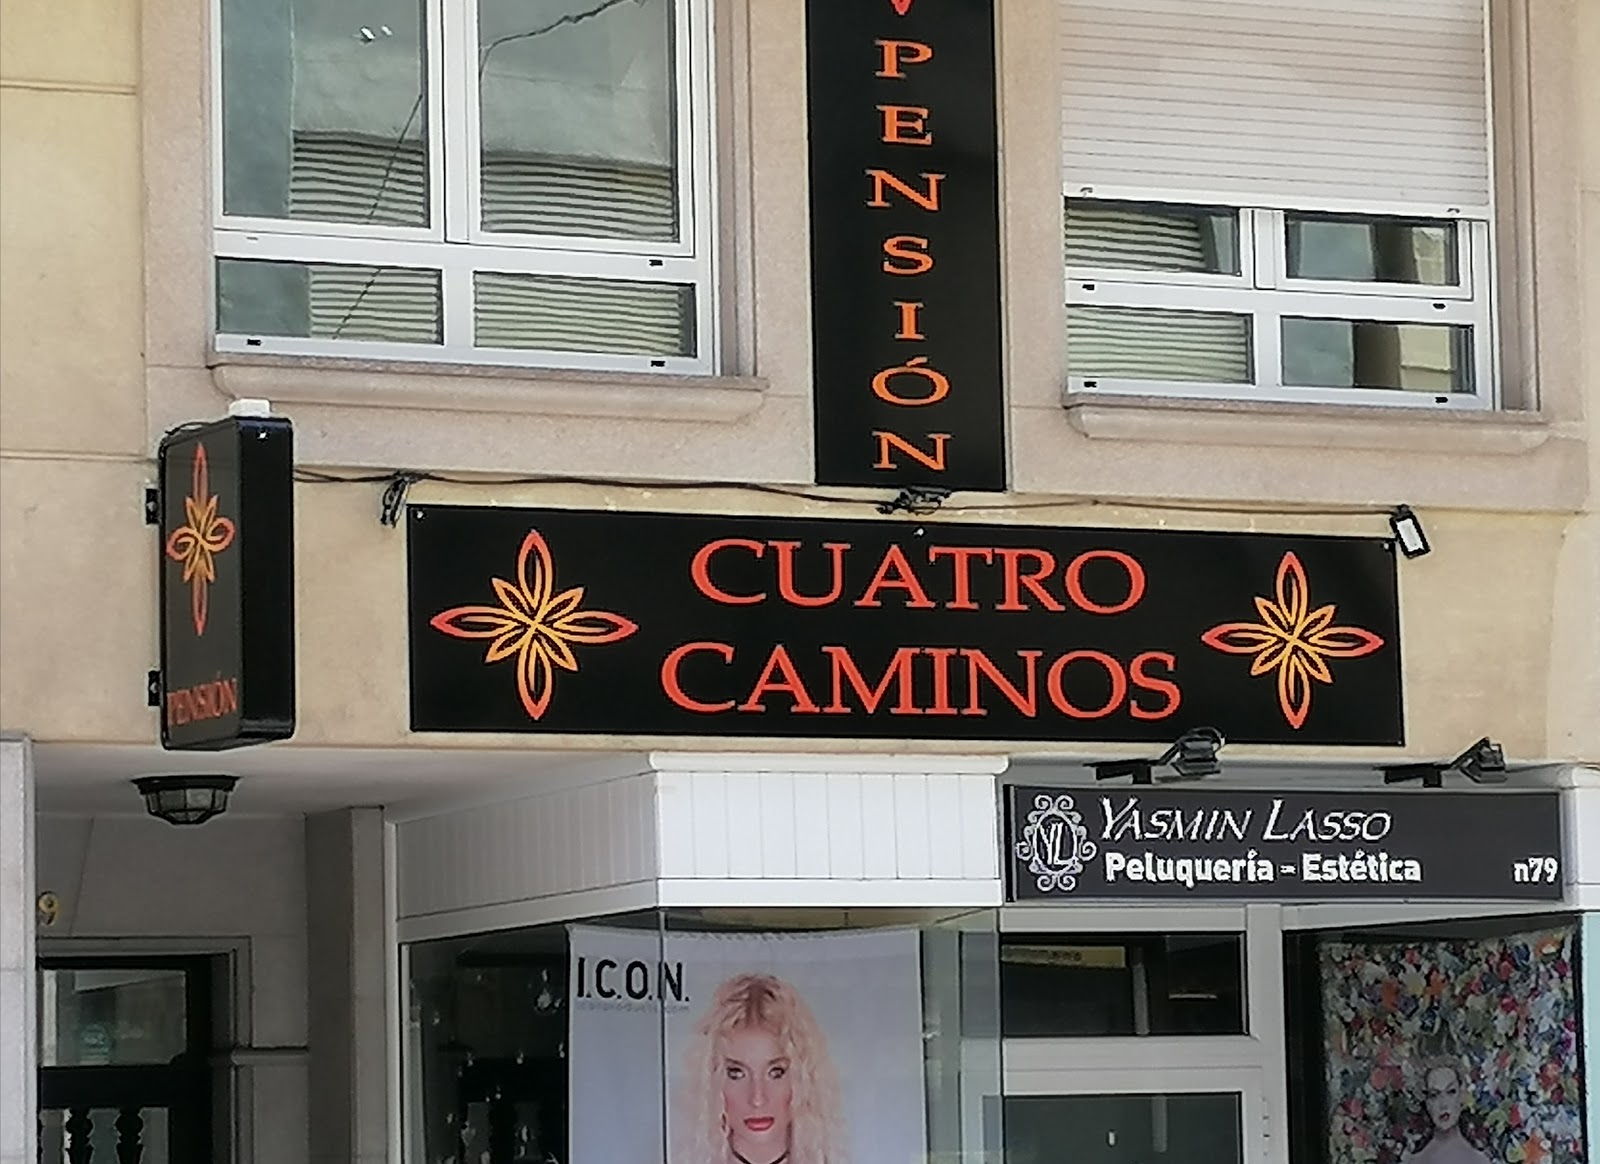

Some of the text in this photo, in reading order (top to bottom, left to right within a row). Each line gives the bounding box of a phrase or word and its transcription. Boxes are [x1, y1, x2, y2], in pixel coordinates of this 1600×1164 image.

[865, 39, 951, 472] PENSIÓN
[691, 538, 1146, 615] CUATRO
[661, 641, 1182, 720] CAMINOS
[1105, 850, 1274, 889] Peluquería
[1302, 850, 1422, 883] Estética
